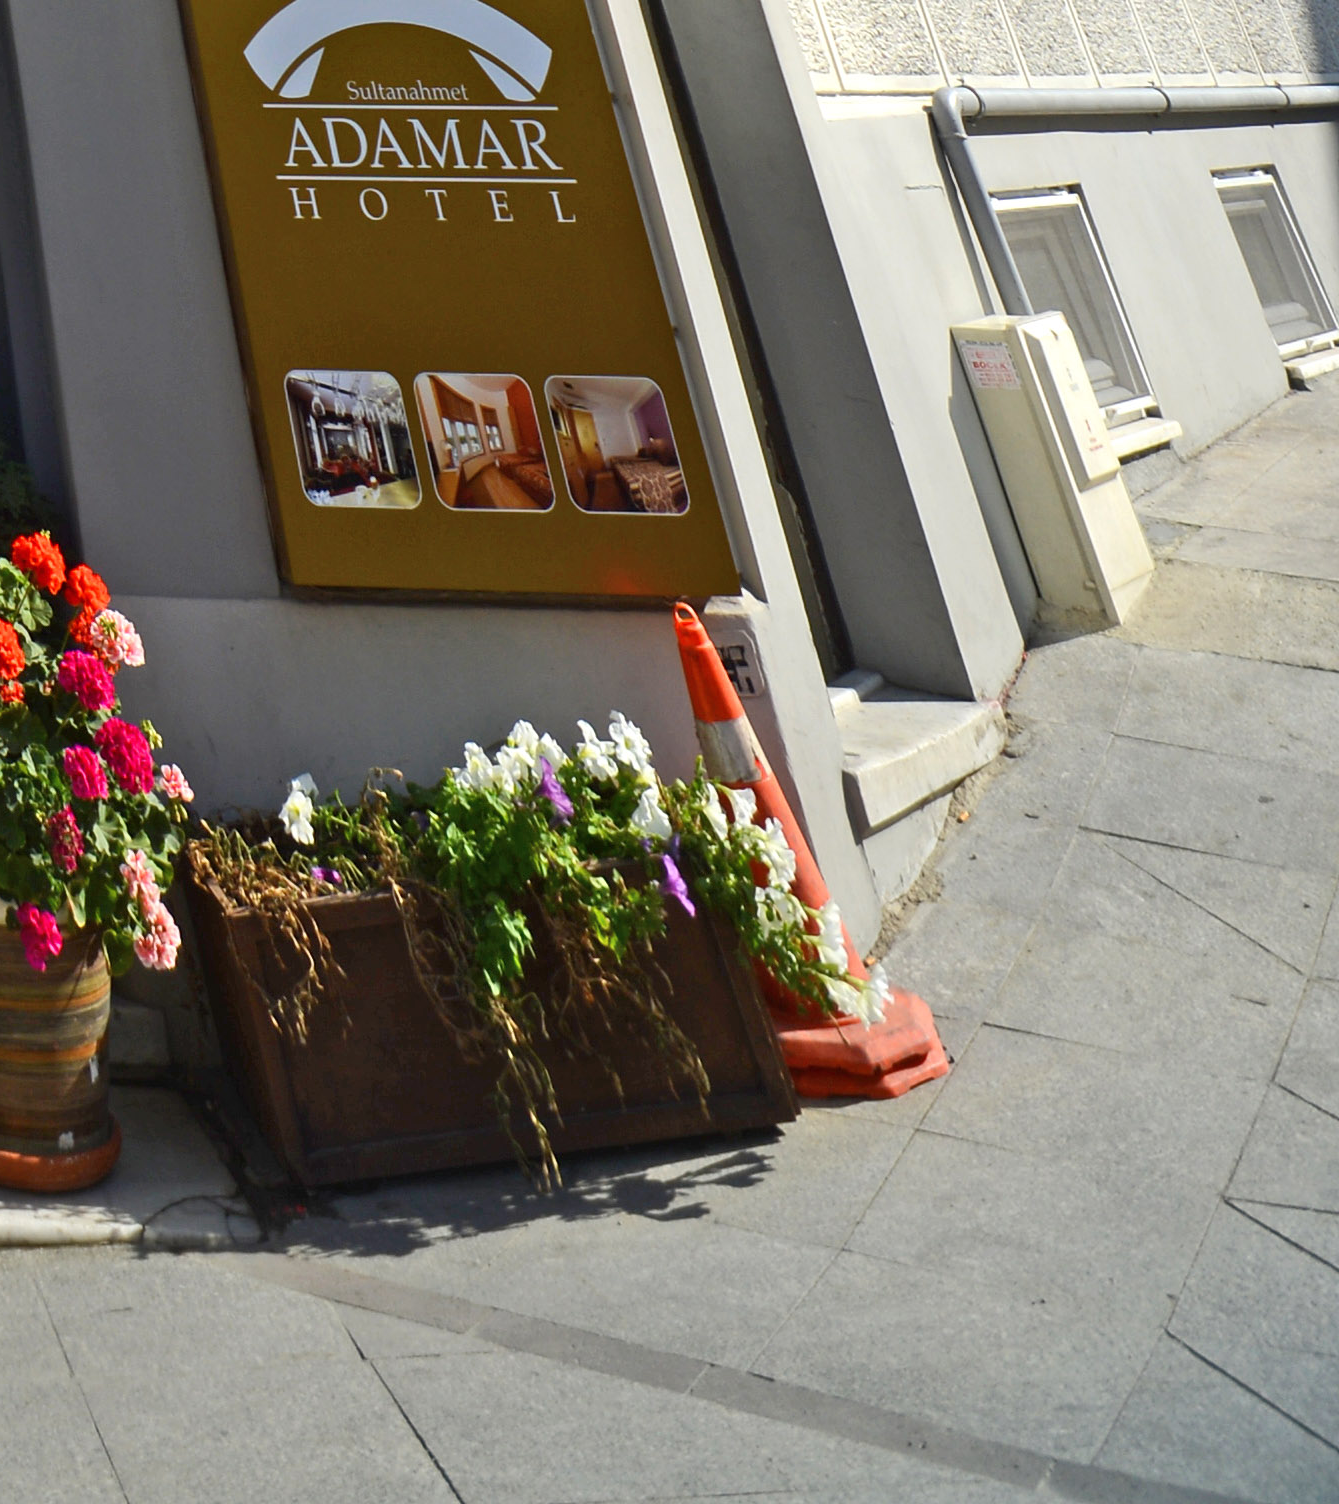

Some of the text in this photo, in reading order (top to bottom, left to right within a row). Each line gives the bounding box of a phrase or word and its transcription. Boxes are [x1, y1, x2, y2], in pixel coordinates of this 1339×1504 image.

[346, 80, 469, 101] Sultanahmet
[284, 117, 564, 170] ADAMAR
[288, 187, 576, 223] HOTEL
